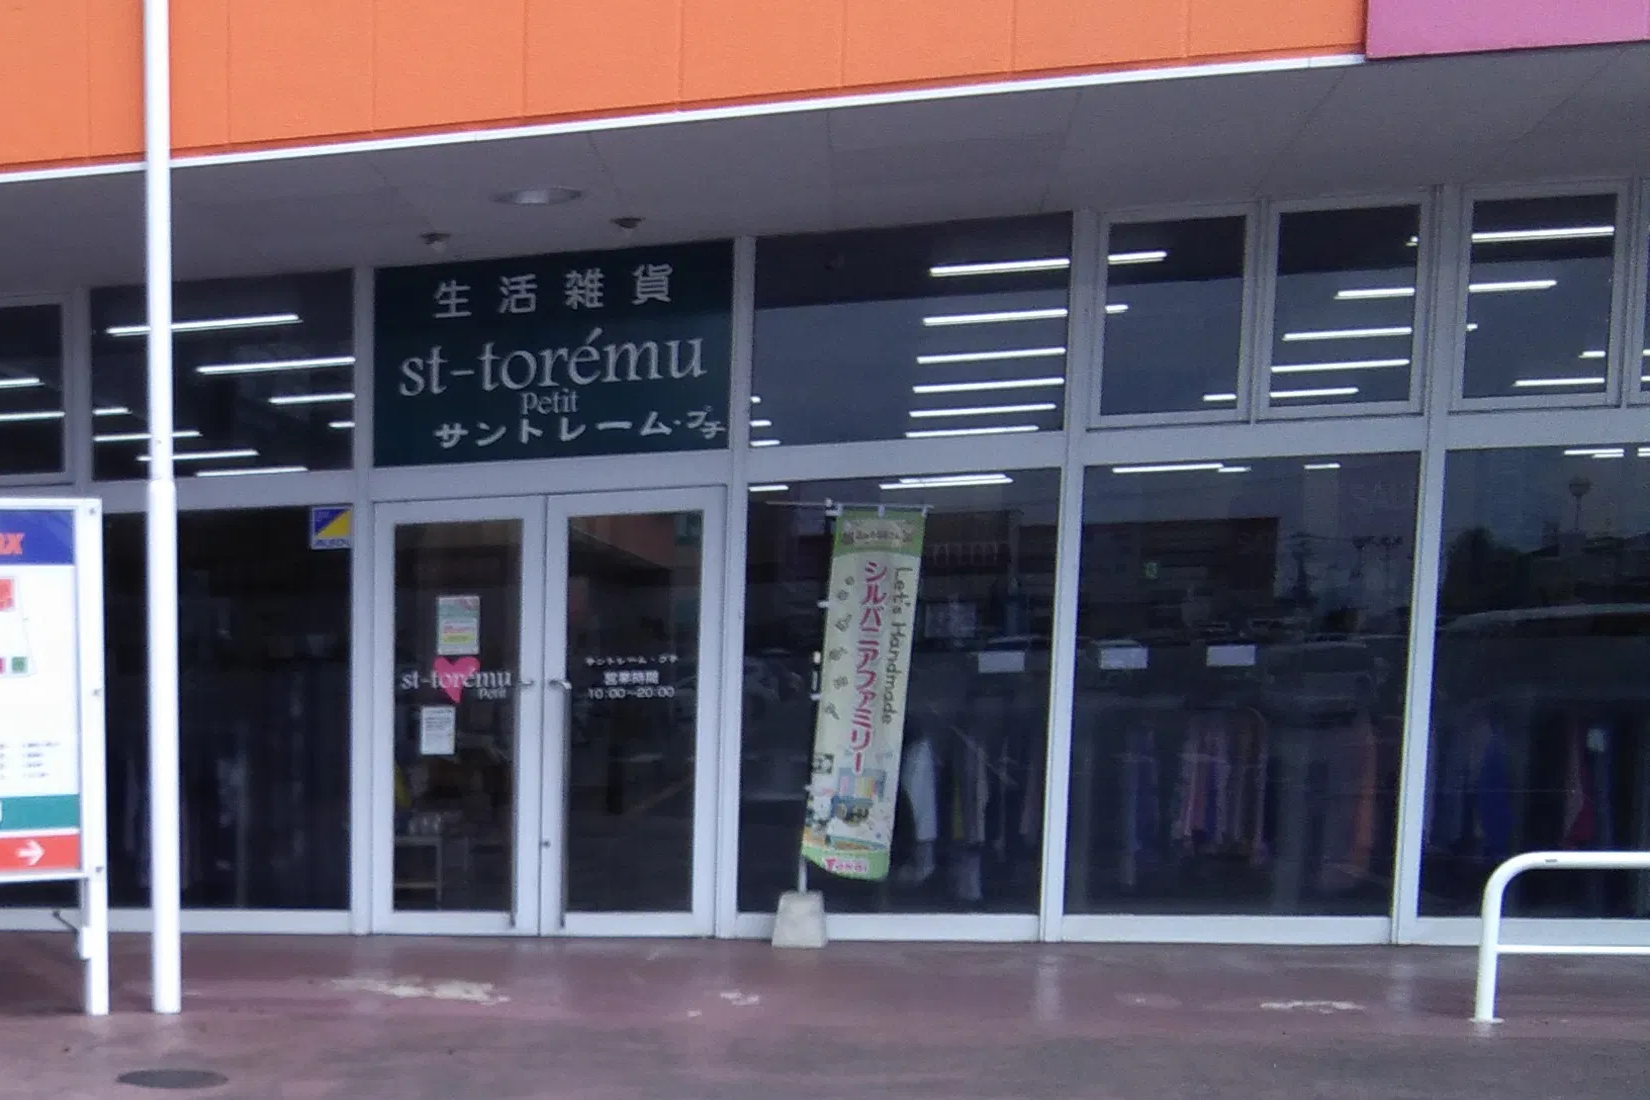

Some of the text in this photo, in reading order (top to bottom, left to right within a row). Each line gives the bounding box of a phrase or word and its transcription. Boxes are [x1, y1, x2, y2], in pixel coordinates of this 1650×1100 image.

[433, 264, 672, 318] 生活雑貨
[399, 328, 707, 397] st-torému
[852, 561, 888, 773] シルバニアファミリー
[881, 566, 914, 726] Let's Handmade
